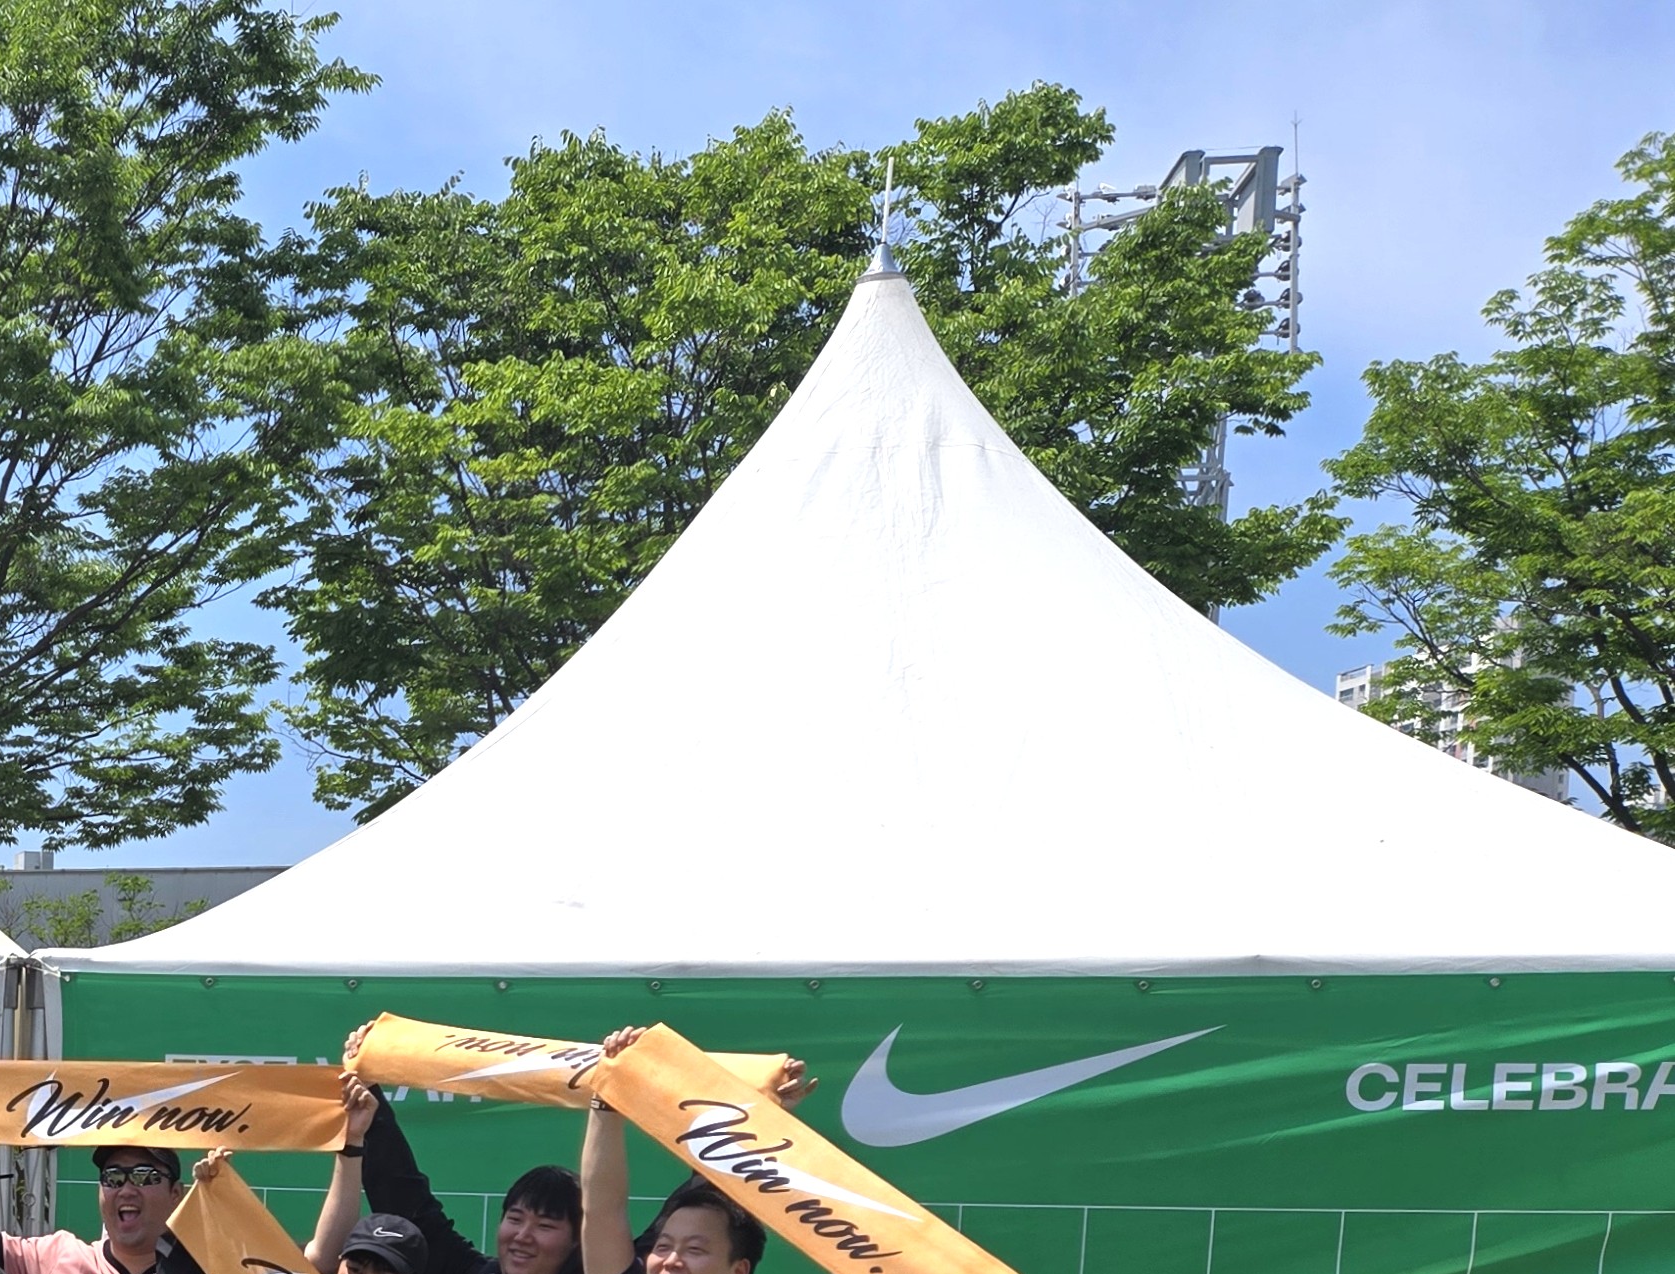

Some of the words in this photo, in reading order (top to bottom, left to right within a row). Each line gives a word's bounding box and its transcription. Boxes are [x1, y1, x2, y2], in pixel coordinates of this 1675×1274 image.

[7, 1076, 138, 1139] Win
[142, 1100, 253, 1134] now.
[676, 1098, 792, 1195] Win
[786, 1198, 903, 1274] now.
